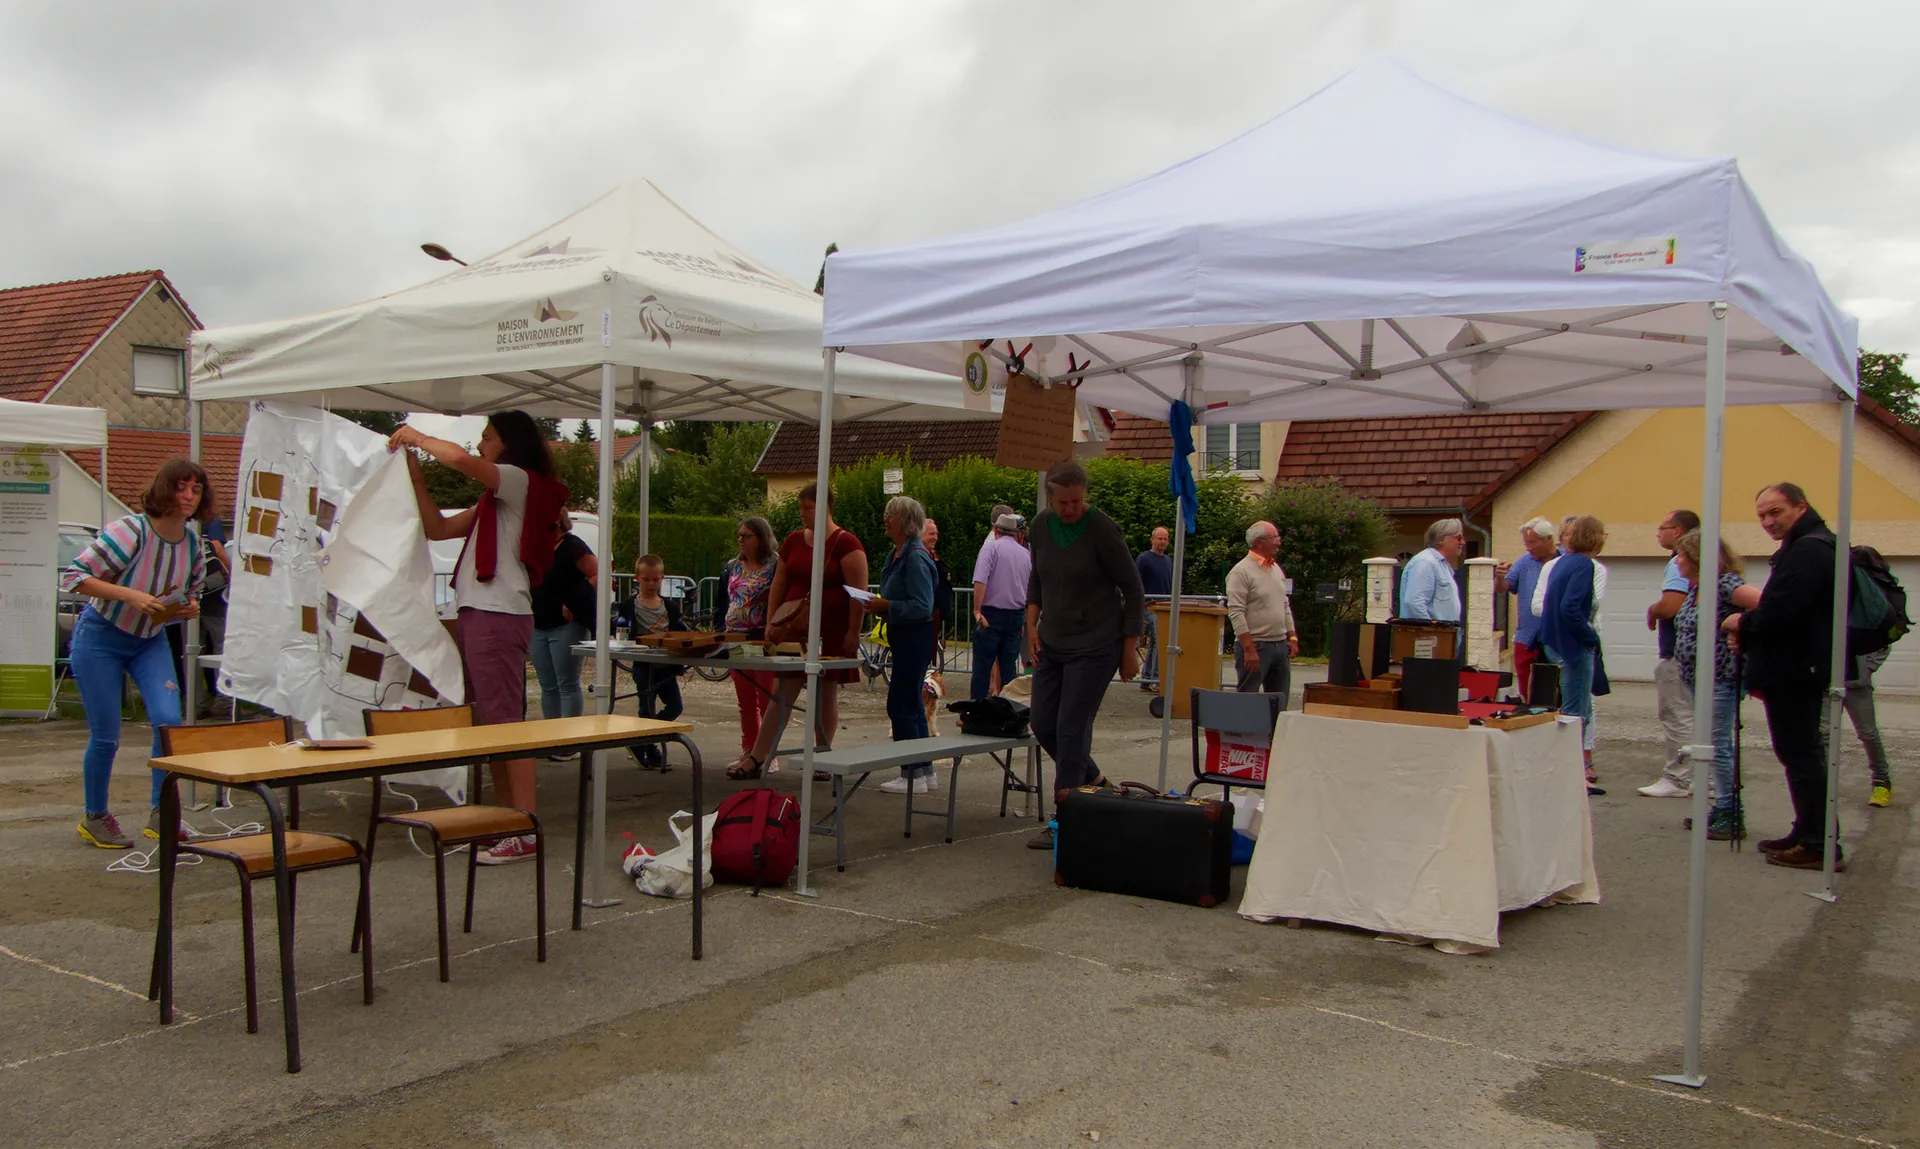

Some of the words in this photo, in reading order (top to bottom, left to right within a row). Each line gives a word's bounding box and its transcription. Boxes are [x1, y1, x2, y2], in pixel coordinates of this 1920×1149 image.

[497, 318, 529, 332] MAISON
[675, 320, 721, 337] Département
[497, 333, 507, 345] DE
[508, 324, 584, 344] L'ENVIRONNEMENT
[1229, 749, 1257, 766] NIKE
